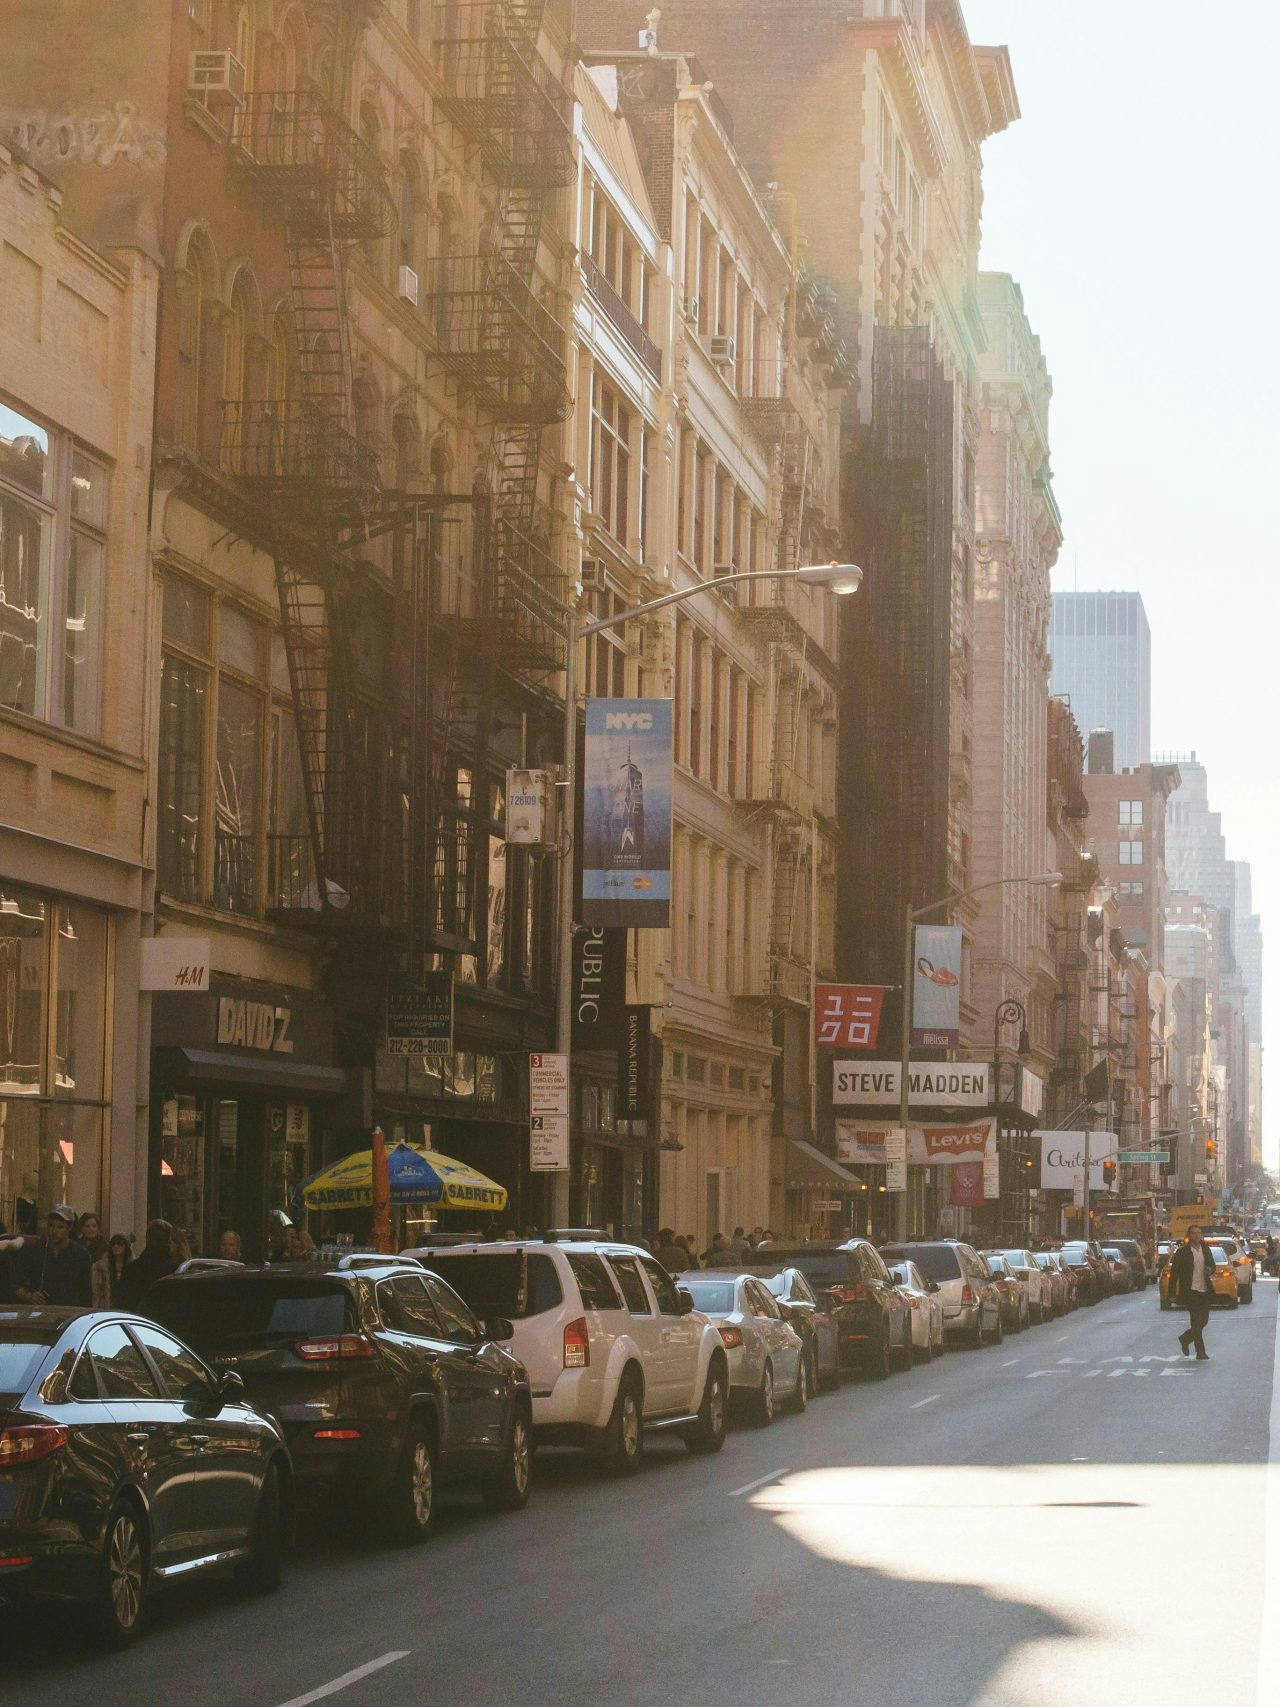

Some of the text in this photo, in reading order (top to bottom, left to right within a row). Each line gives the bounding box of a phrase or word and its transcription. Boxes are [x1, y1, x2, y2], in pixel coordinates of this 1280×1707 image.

[606, 713, 652, 729] NYC
[510, 795, 536, 805] 726109
[175, 966, 204, 986] H&M
[217, 997, 294, 1053] DAVID Z
[923, 1033, 948, 1045] melissa
[534, 1056, 539, 1067] 3
[628, 1015, 638, 1112] BANANA REPUBLIC
[838, 1073, 984, 1093] STEVE MADDEN
[535, 1118, 540, 1129] 2
[448, 1184, 504, 1205] SABRETT
[1024, 1368, 1198, 1378] FIRE
